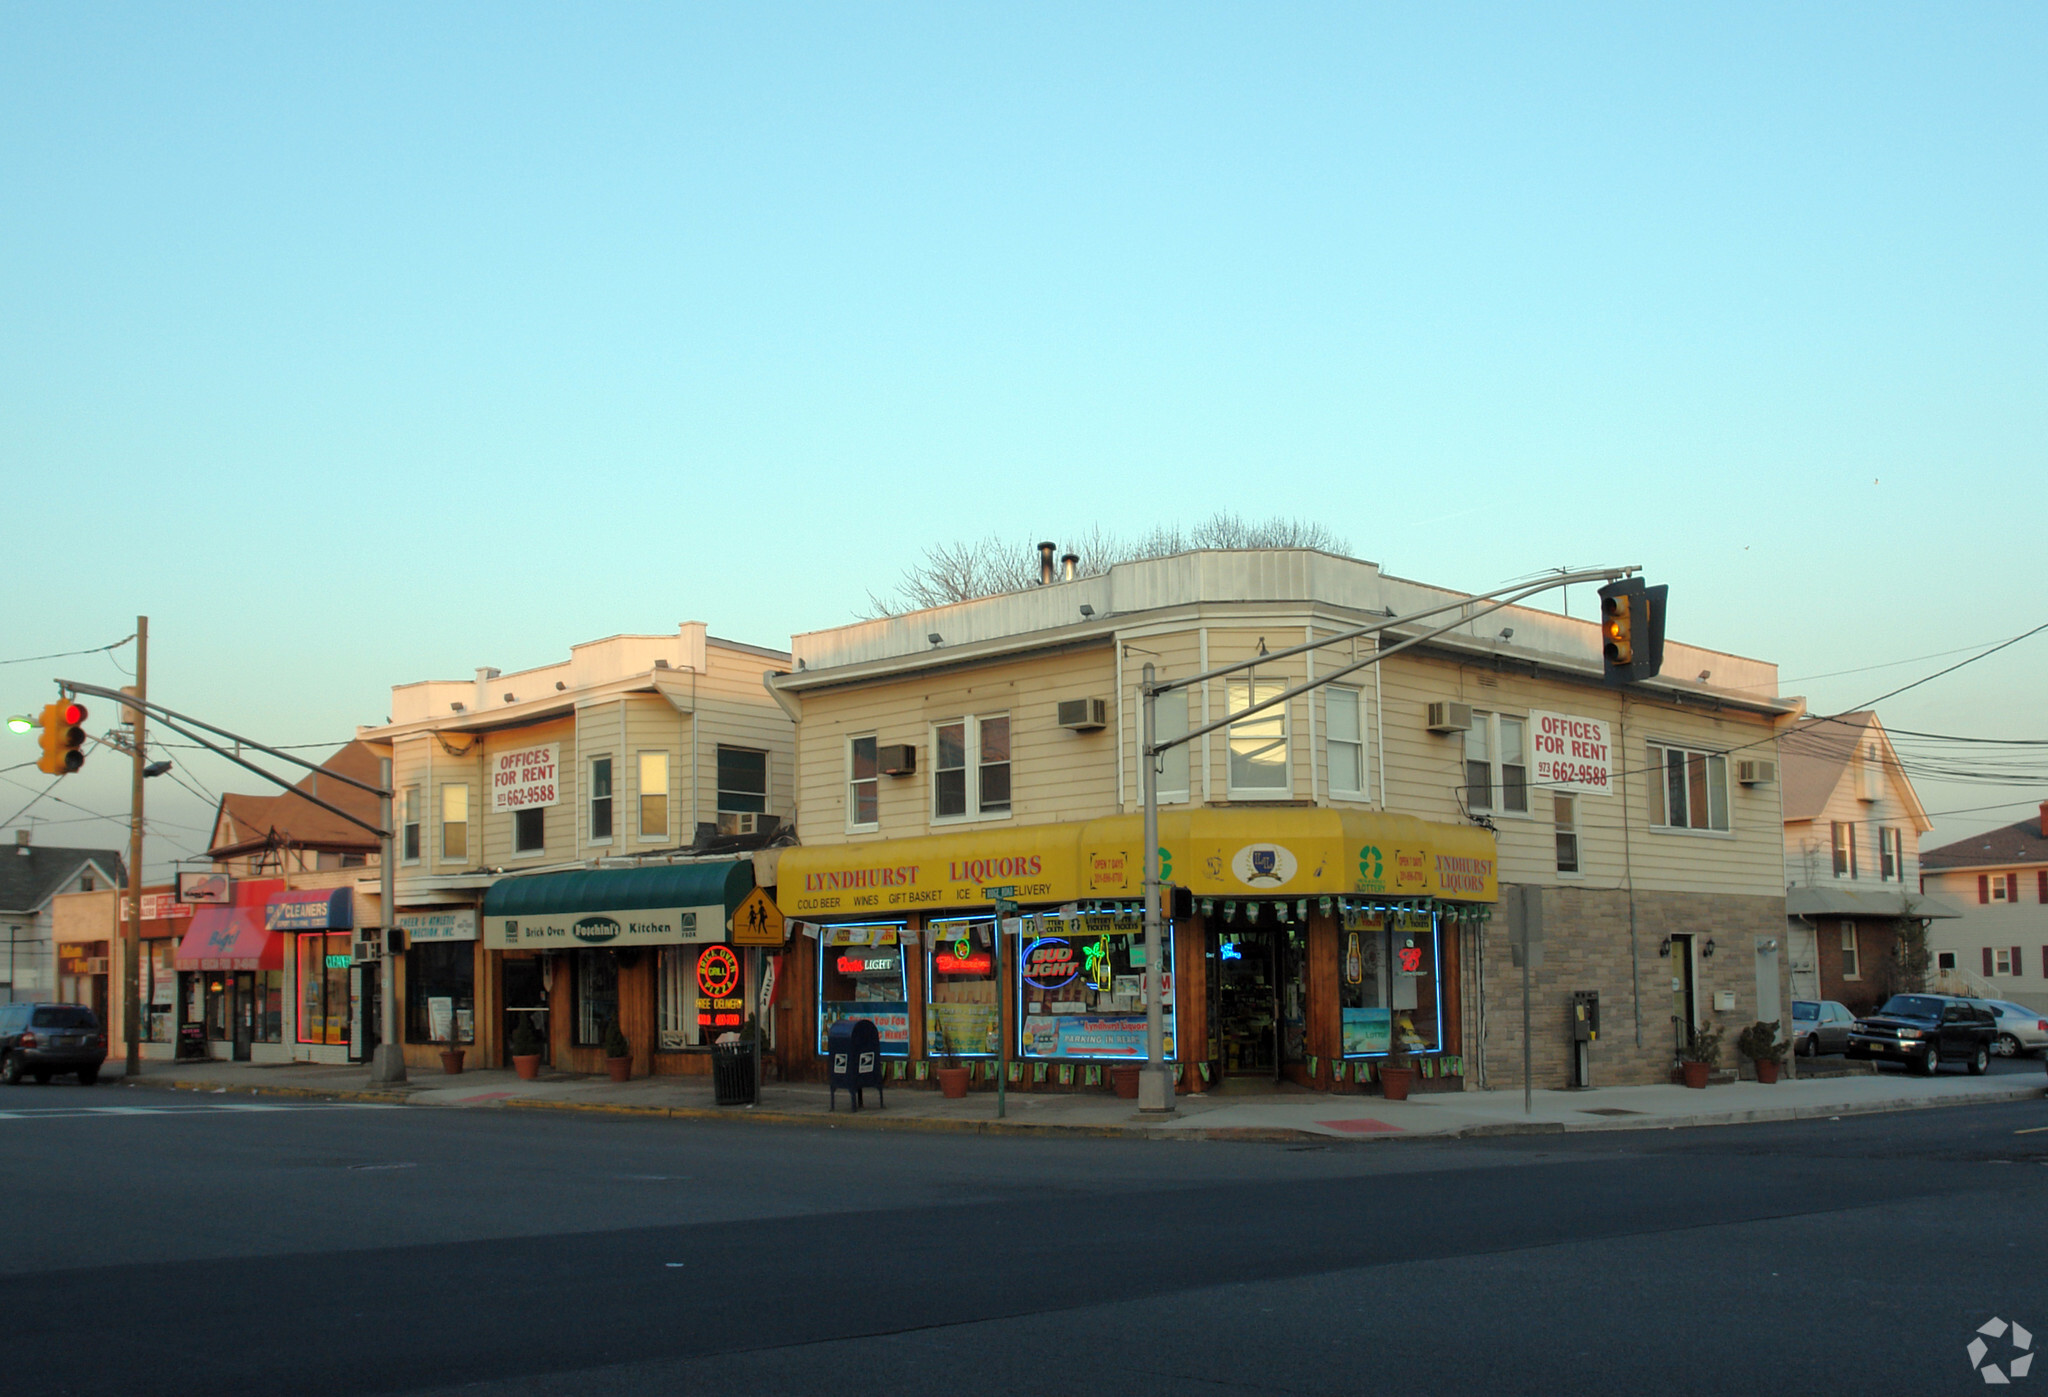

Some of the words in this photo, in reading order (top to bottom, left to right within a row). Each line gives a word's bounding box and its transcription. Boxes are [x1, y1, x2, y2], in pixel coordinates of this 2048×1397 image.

[1541, 716, 1601, 741] OFFICES
[1535, 734, 1564, 755] FOR
[1571, 740, 1608, 761] RENT
[500, 748, 550, 770] OFFICES
[495, 770, 516, 787] FOR
[522, 764, 555, 782] RENT
[1538, 761, 1551, 773] 973
[1552, 760, 1607, 786] 662-9588
[507, 784, 554, 806] 662-9588
[1094, 859, 1107, 869] OPEN
[1112, 859, 1124, 869] DAYS
[805, 865, 919, 893] LYNDHURST
[949, 855, 1042, 885] LIQUORS
[1440, 872, 1485, 895] LIQUORS
[798, 899, 818, 910] COLD
[820, 897, 841, 909] BEER
[853, 895, 879, 906] WINES
[889, 892, 906, 904] GIFT
[909, 890, 943, 902] BASKET
[956, 888, 970, 899] ICE
[1013, 884, 1052, 896] ELIVERY
[285, 902, 328, 918] CLEANERS
[400, 916, 418, 927] CHEER
[428, 915, 456, 926] ATHLETIC
[525, 927, 544, 937] Brick
[547, 926, 565, 936] Oven
[629, 921, 671, 934] Kitchen
[1087, 924, 1111, 932] TICKETS
[720, 949, 737, 973] OVEN
[1032, 948, 1073, 963] BUD
[708, 966, 727, 976] GRILL
[864, 958, 892, 970] LIGHT
[1023, 962, 1079, 977] LIGHT
[704, 981, 733, 995] PIZZA
[695, 998, 711, 1009] FREE
[713, 998, 743, 1009] DELIVERY
[891, 1015, 906, 1026] FOR
[1064, 1035, 1102, 1044] PARKING
[1105, 1035, 1114, 1044] IN
